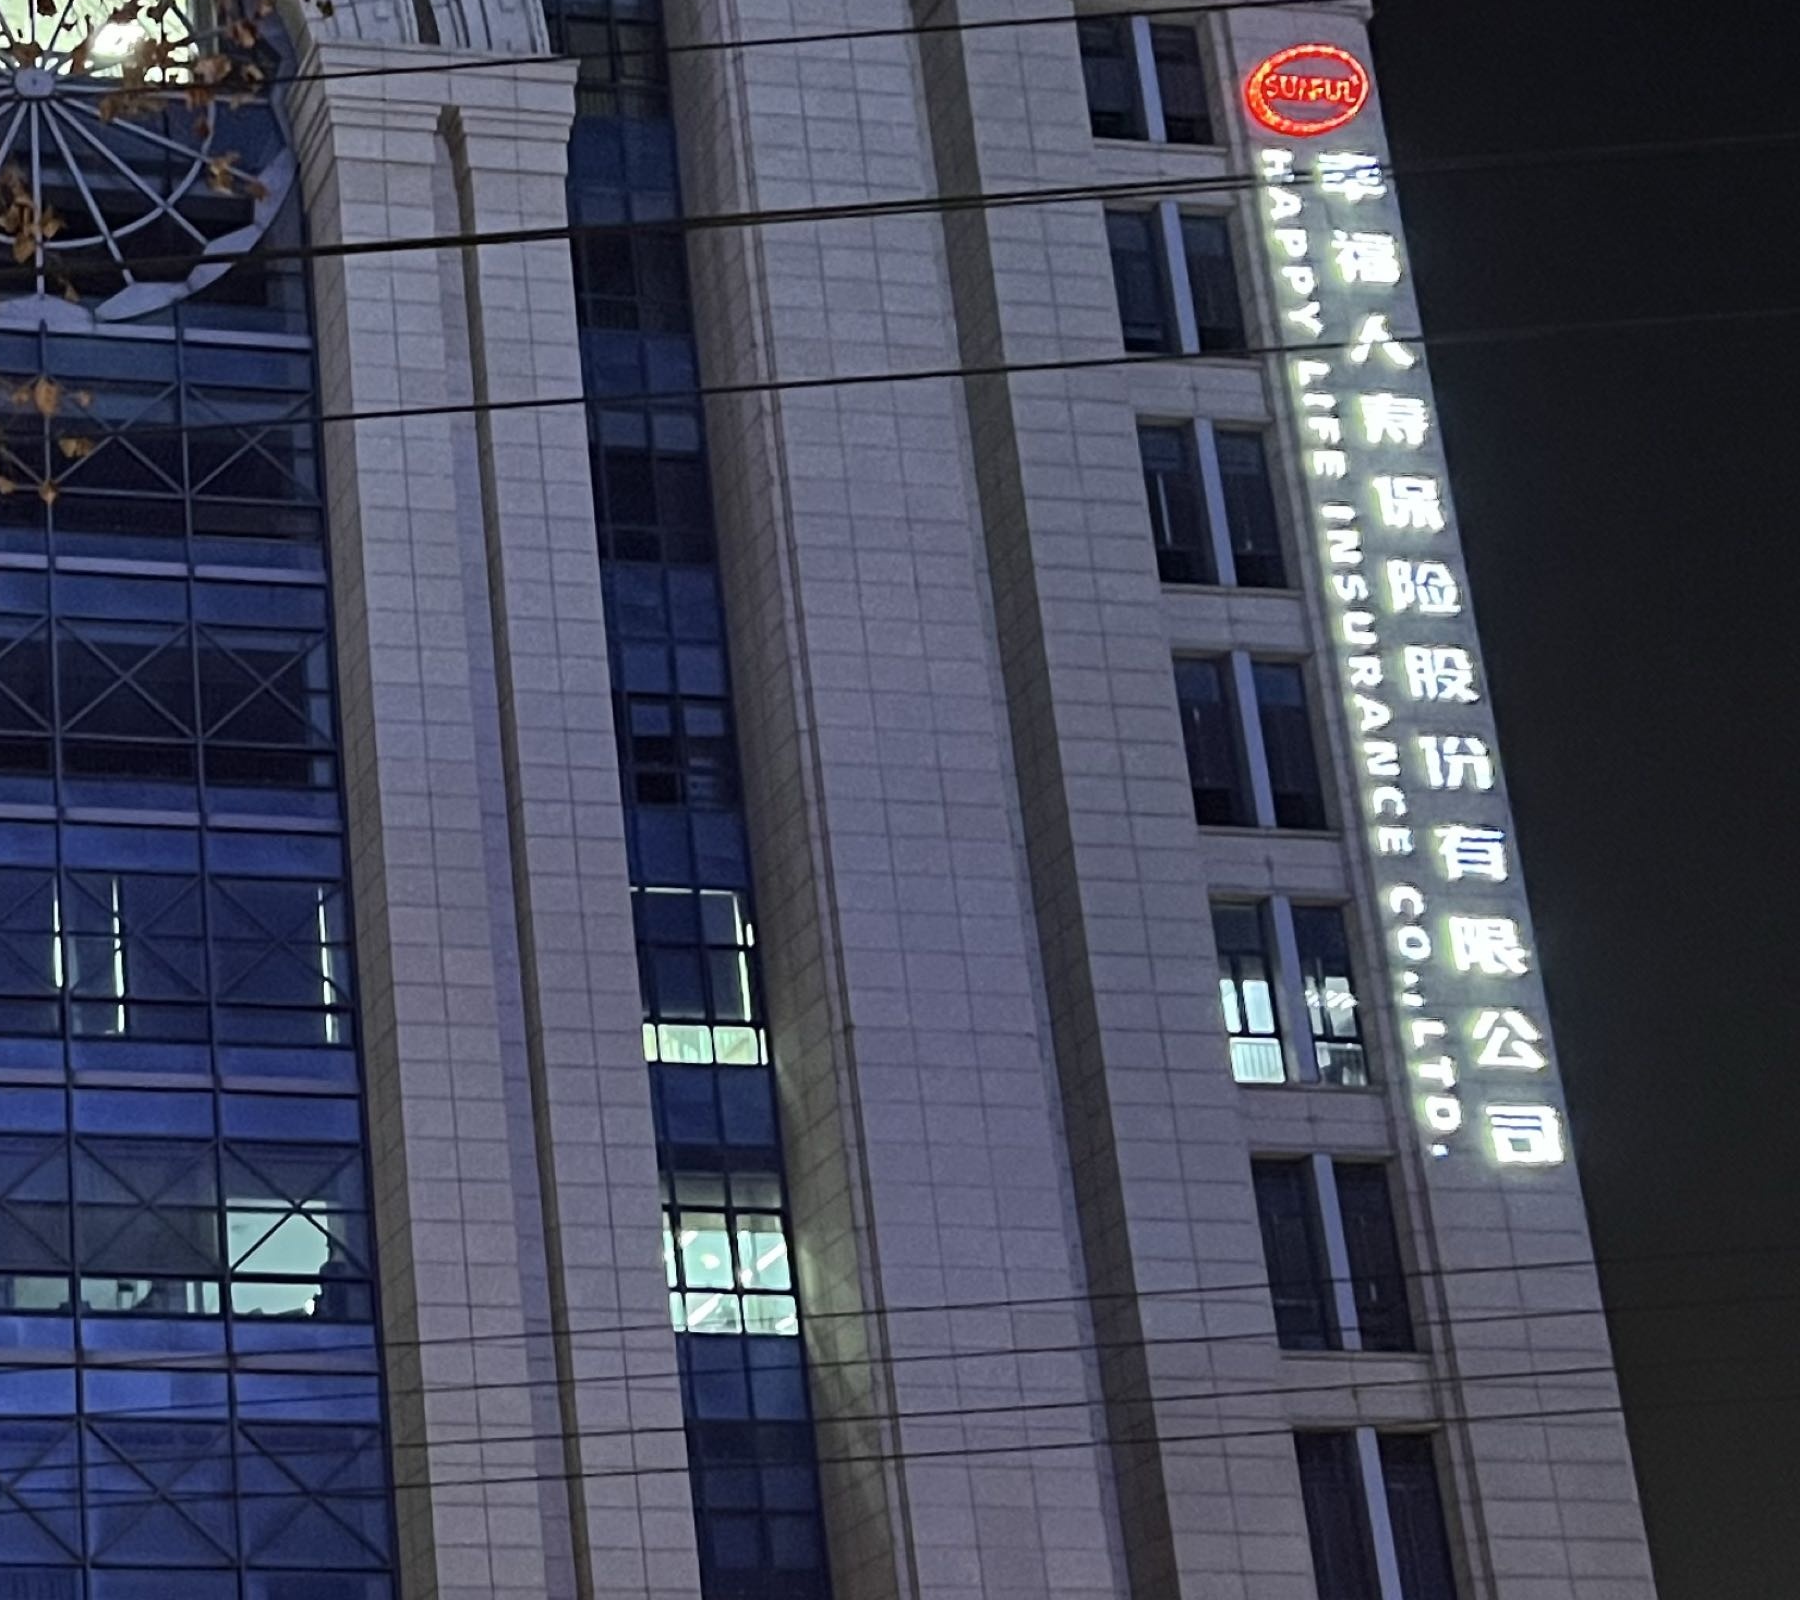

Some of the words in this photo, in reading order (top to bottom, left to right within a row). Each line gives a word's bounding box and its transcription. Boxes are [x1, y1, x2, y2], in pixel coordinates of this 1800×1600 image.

[1260, 148, 1325, 338] HAPPY
[1295, 359, 1347, 478] LIFE
[1316, 149, 1567, 1166] 幸福人寿保险股份有限公司
[1319, 501, 1415, 855] INSURANCE
